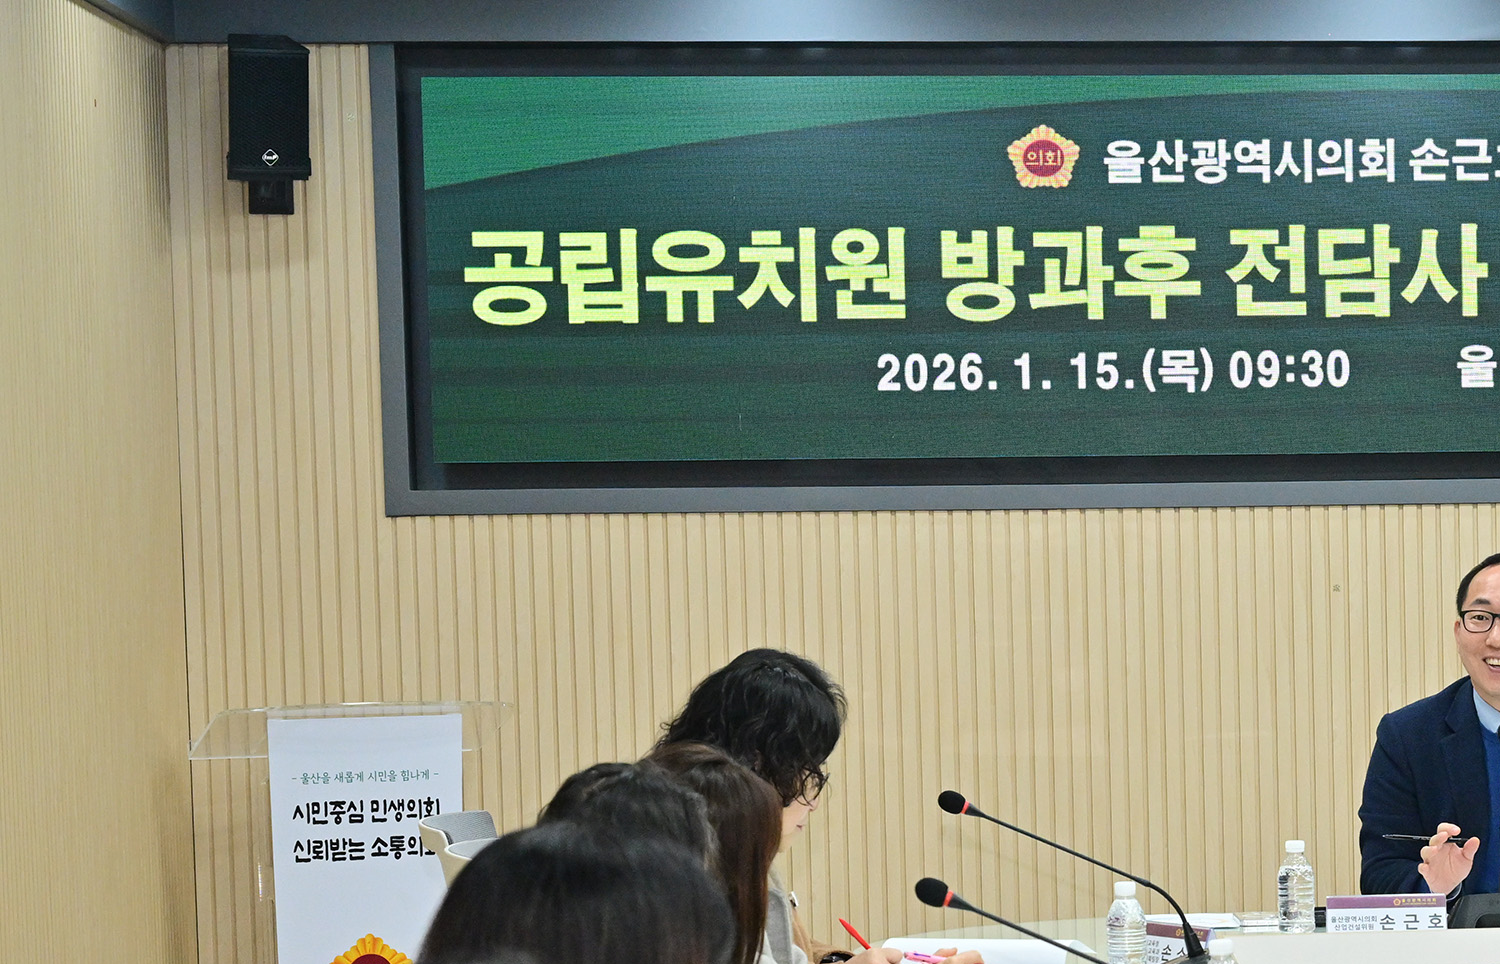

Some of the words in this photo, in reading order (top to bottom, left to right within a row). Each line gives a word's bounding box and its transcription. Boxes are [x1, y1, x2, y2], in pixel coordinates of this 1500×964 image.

[1026, 147, 1064, 171] 의회
[1104, 138, 1396, 185] 울산광역시의회
[463, 226, 907, 326] 공립유치원
[940, 225, 1202, 322] 방과후
[1225, 223, 1489, 318] 전담사
[877, 352, 998, 393] 2026.
[1013, 352, 1052, 391] 1.
[1229, 349, 1350, 390] 09:30
[301, 772, 331, 785] 울산을
[334, 771, 364, 784] 새롭게
[368, 769, 397, 783] 시민을
[401, 768, 430, 781] 힘나게
[293, 799, 365, 826] 시민중심
[370, 796, 440, 823] 민생의회
[293, 837, 366, 864] 신뢰받는
[1331, 915, 1378, 924] 울산광역시의회
